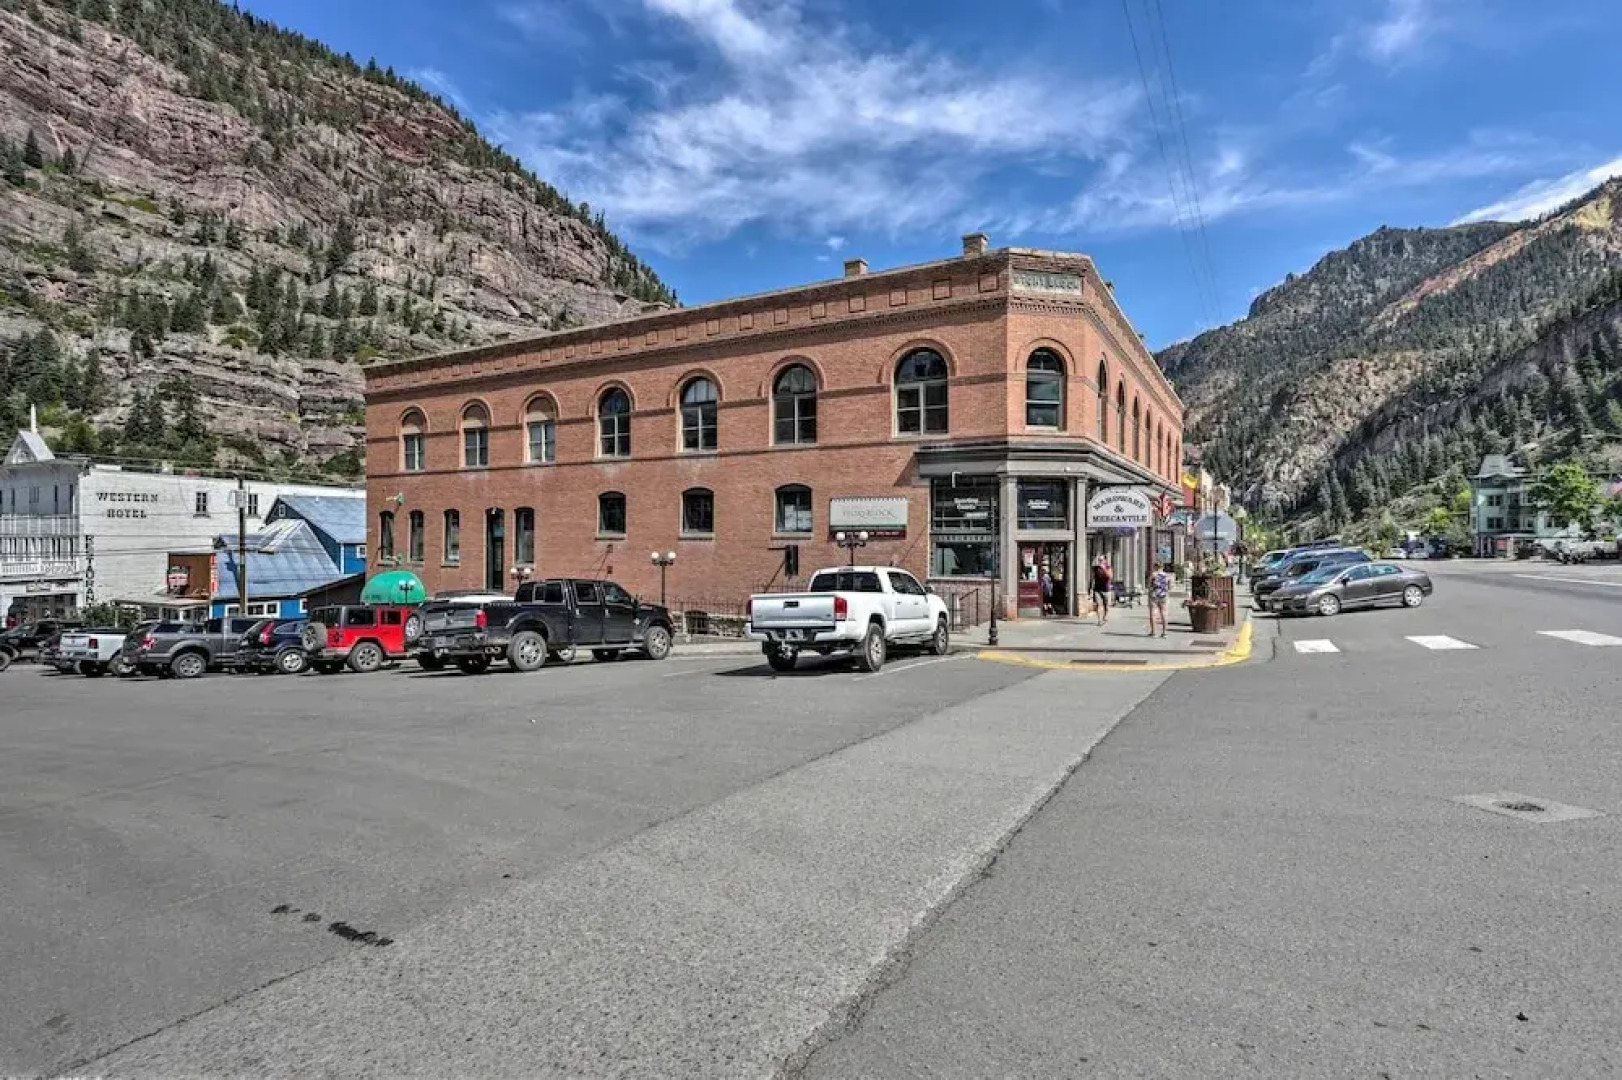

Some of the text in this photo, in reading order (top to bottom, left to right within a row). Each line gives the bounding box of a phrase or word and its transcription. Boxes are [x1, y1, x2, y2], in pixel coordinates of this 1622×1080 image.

[95, 492, 159, 503] WESTERN
[1093, 495, 1146, 510] HARDWARE
[106, 508, 147, 519] HOTEL
[1114, 504, 1124, 513] &
[1092, 515, 1148, 523] MERCANTILE
